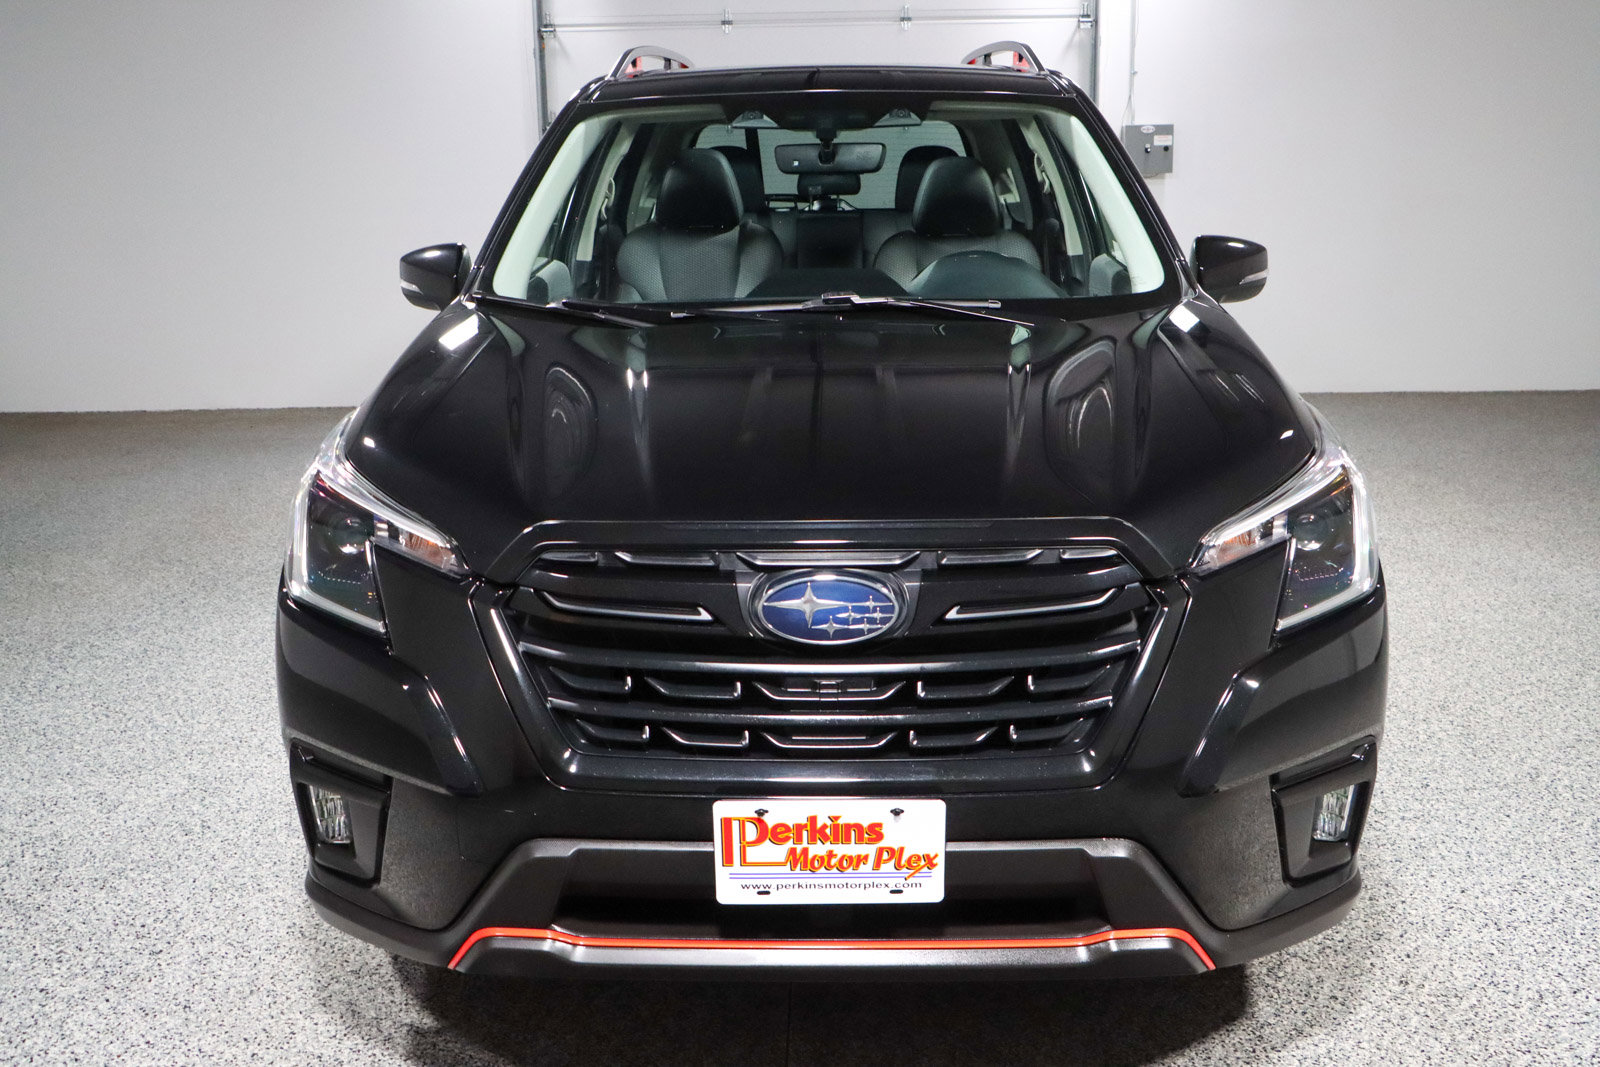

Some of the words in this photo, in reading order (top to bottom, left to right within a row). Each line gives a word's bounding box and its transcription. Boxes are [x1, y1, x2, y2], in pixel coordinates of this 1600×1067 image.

[721, 815, 885, 867] Perkins
[785, 846, 869, 872] Motor
[872, 846, 939, 880] Plex
[740, 880, 922, 891] www.perkinsmotorplex.com
